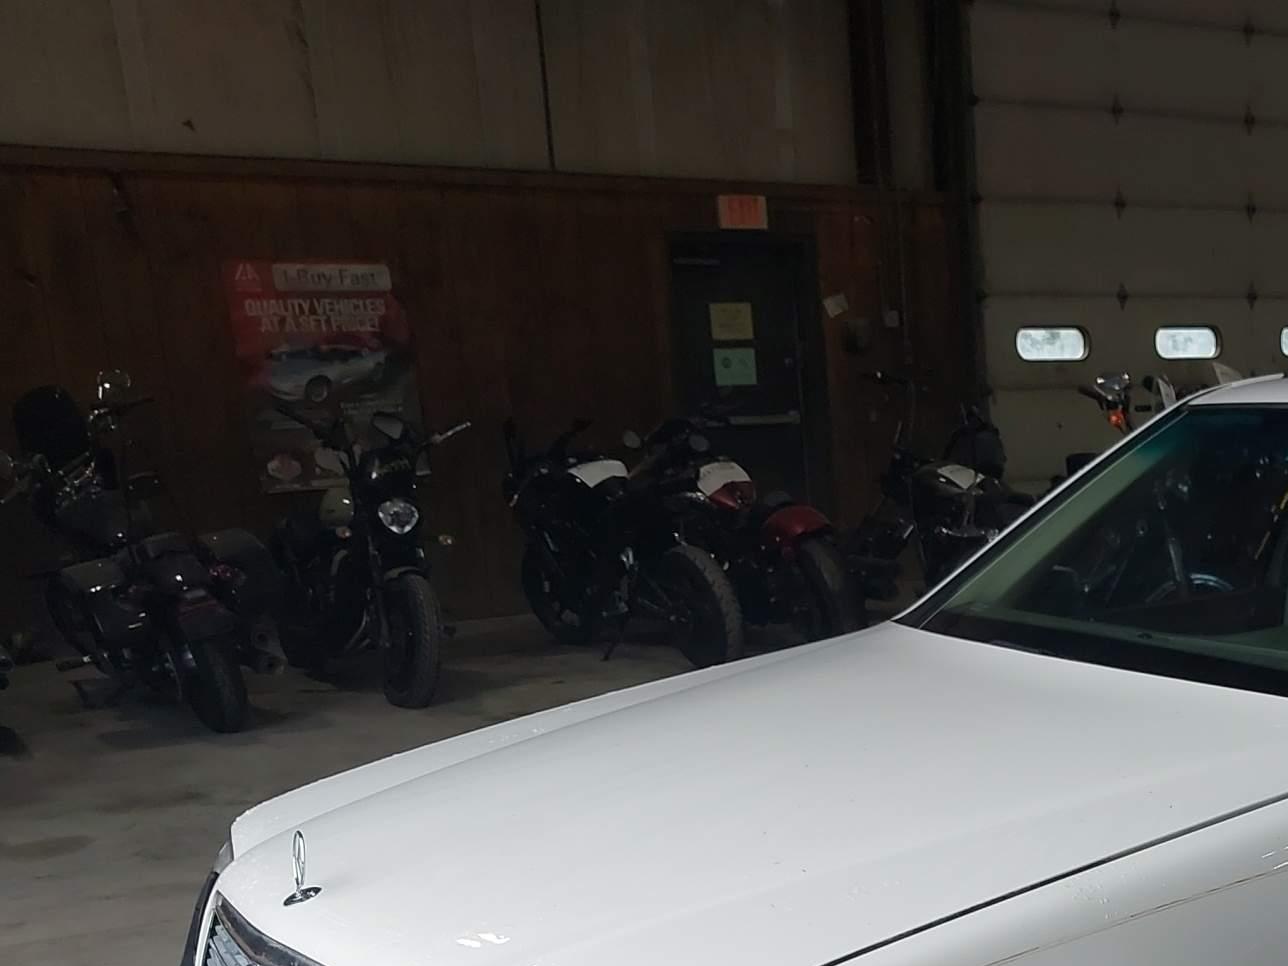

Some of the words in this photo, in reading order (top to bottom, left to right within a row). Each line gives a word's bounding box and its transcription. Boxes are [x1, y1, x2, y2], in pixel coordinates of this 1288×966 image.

[339, 268, 378, 286] Fast
[245, 298, 311, 317] QUALITY
[315, 297, 386, 317] VEHICLES
[261, 316, 282, 333] AT
[286, 316, 297, 333] A
